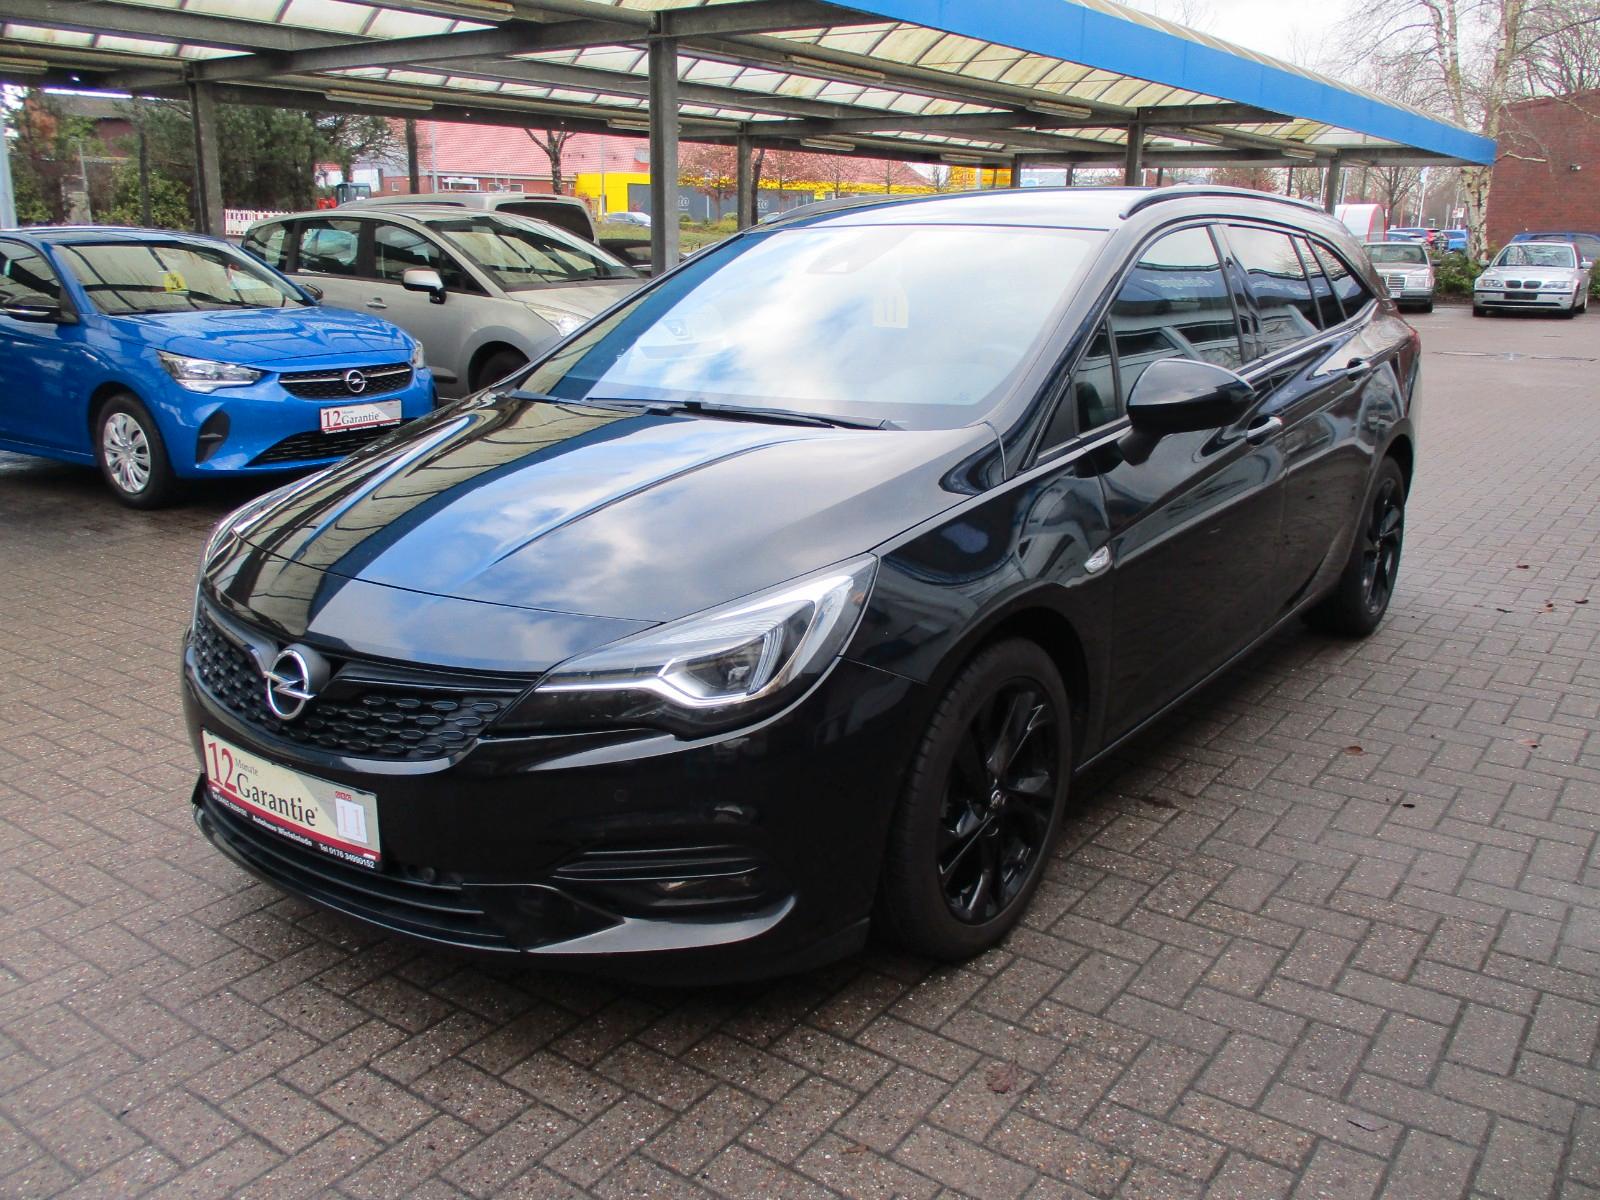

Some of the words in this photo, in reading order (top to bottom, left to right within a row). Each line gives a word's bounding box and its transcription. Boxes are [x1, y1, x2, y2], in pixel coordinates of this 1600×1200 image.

[323, 410, 341, 427] 12
[341, 412, 379, 425] Garantie
[208, 742, 237, 794] 12
[234, 758, 259, 777] Monate
[237, 772, 316, 827] Garantie
